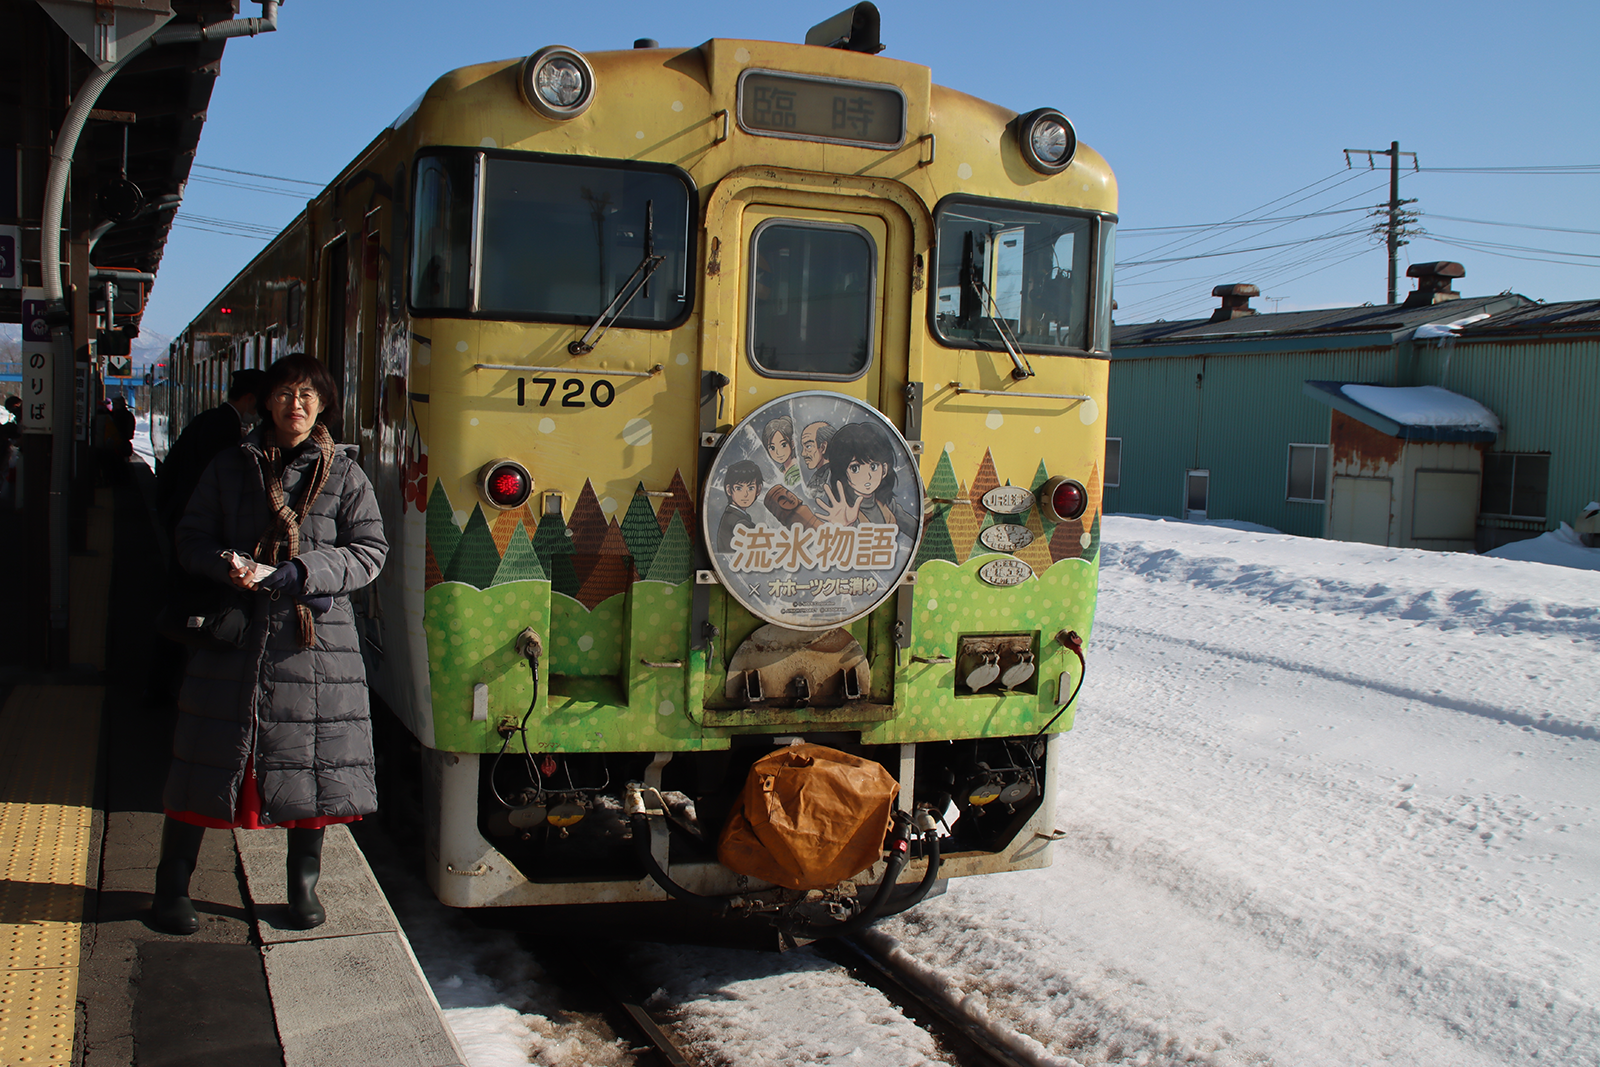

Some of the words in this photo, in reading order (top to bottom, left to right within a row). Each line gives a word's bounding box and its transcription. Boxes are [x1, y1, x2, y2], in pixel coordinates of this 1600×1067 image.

[752, 86, 875, 136] 臨時
[30, 353, 46, 420] のりば
[517, 377, 616, 408] 1720
[731, 524, 897, 570] 流氷物語
[768, 577, 878, 597] オホーツクに消ゆ
